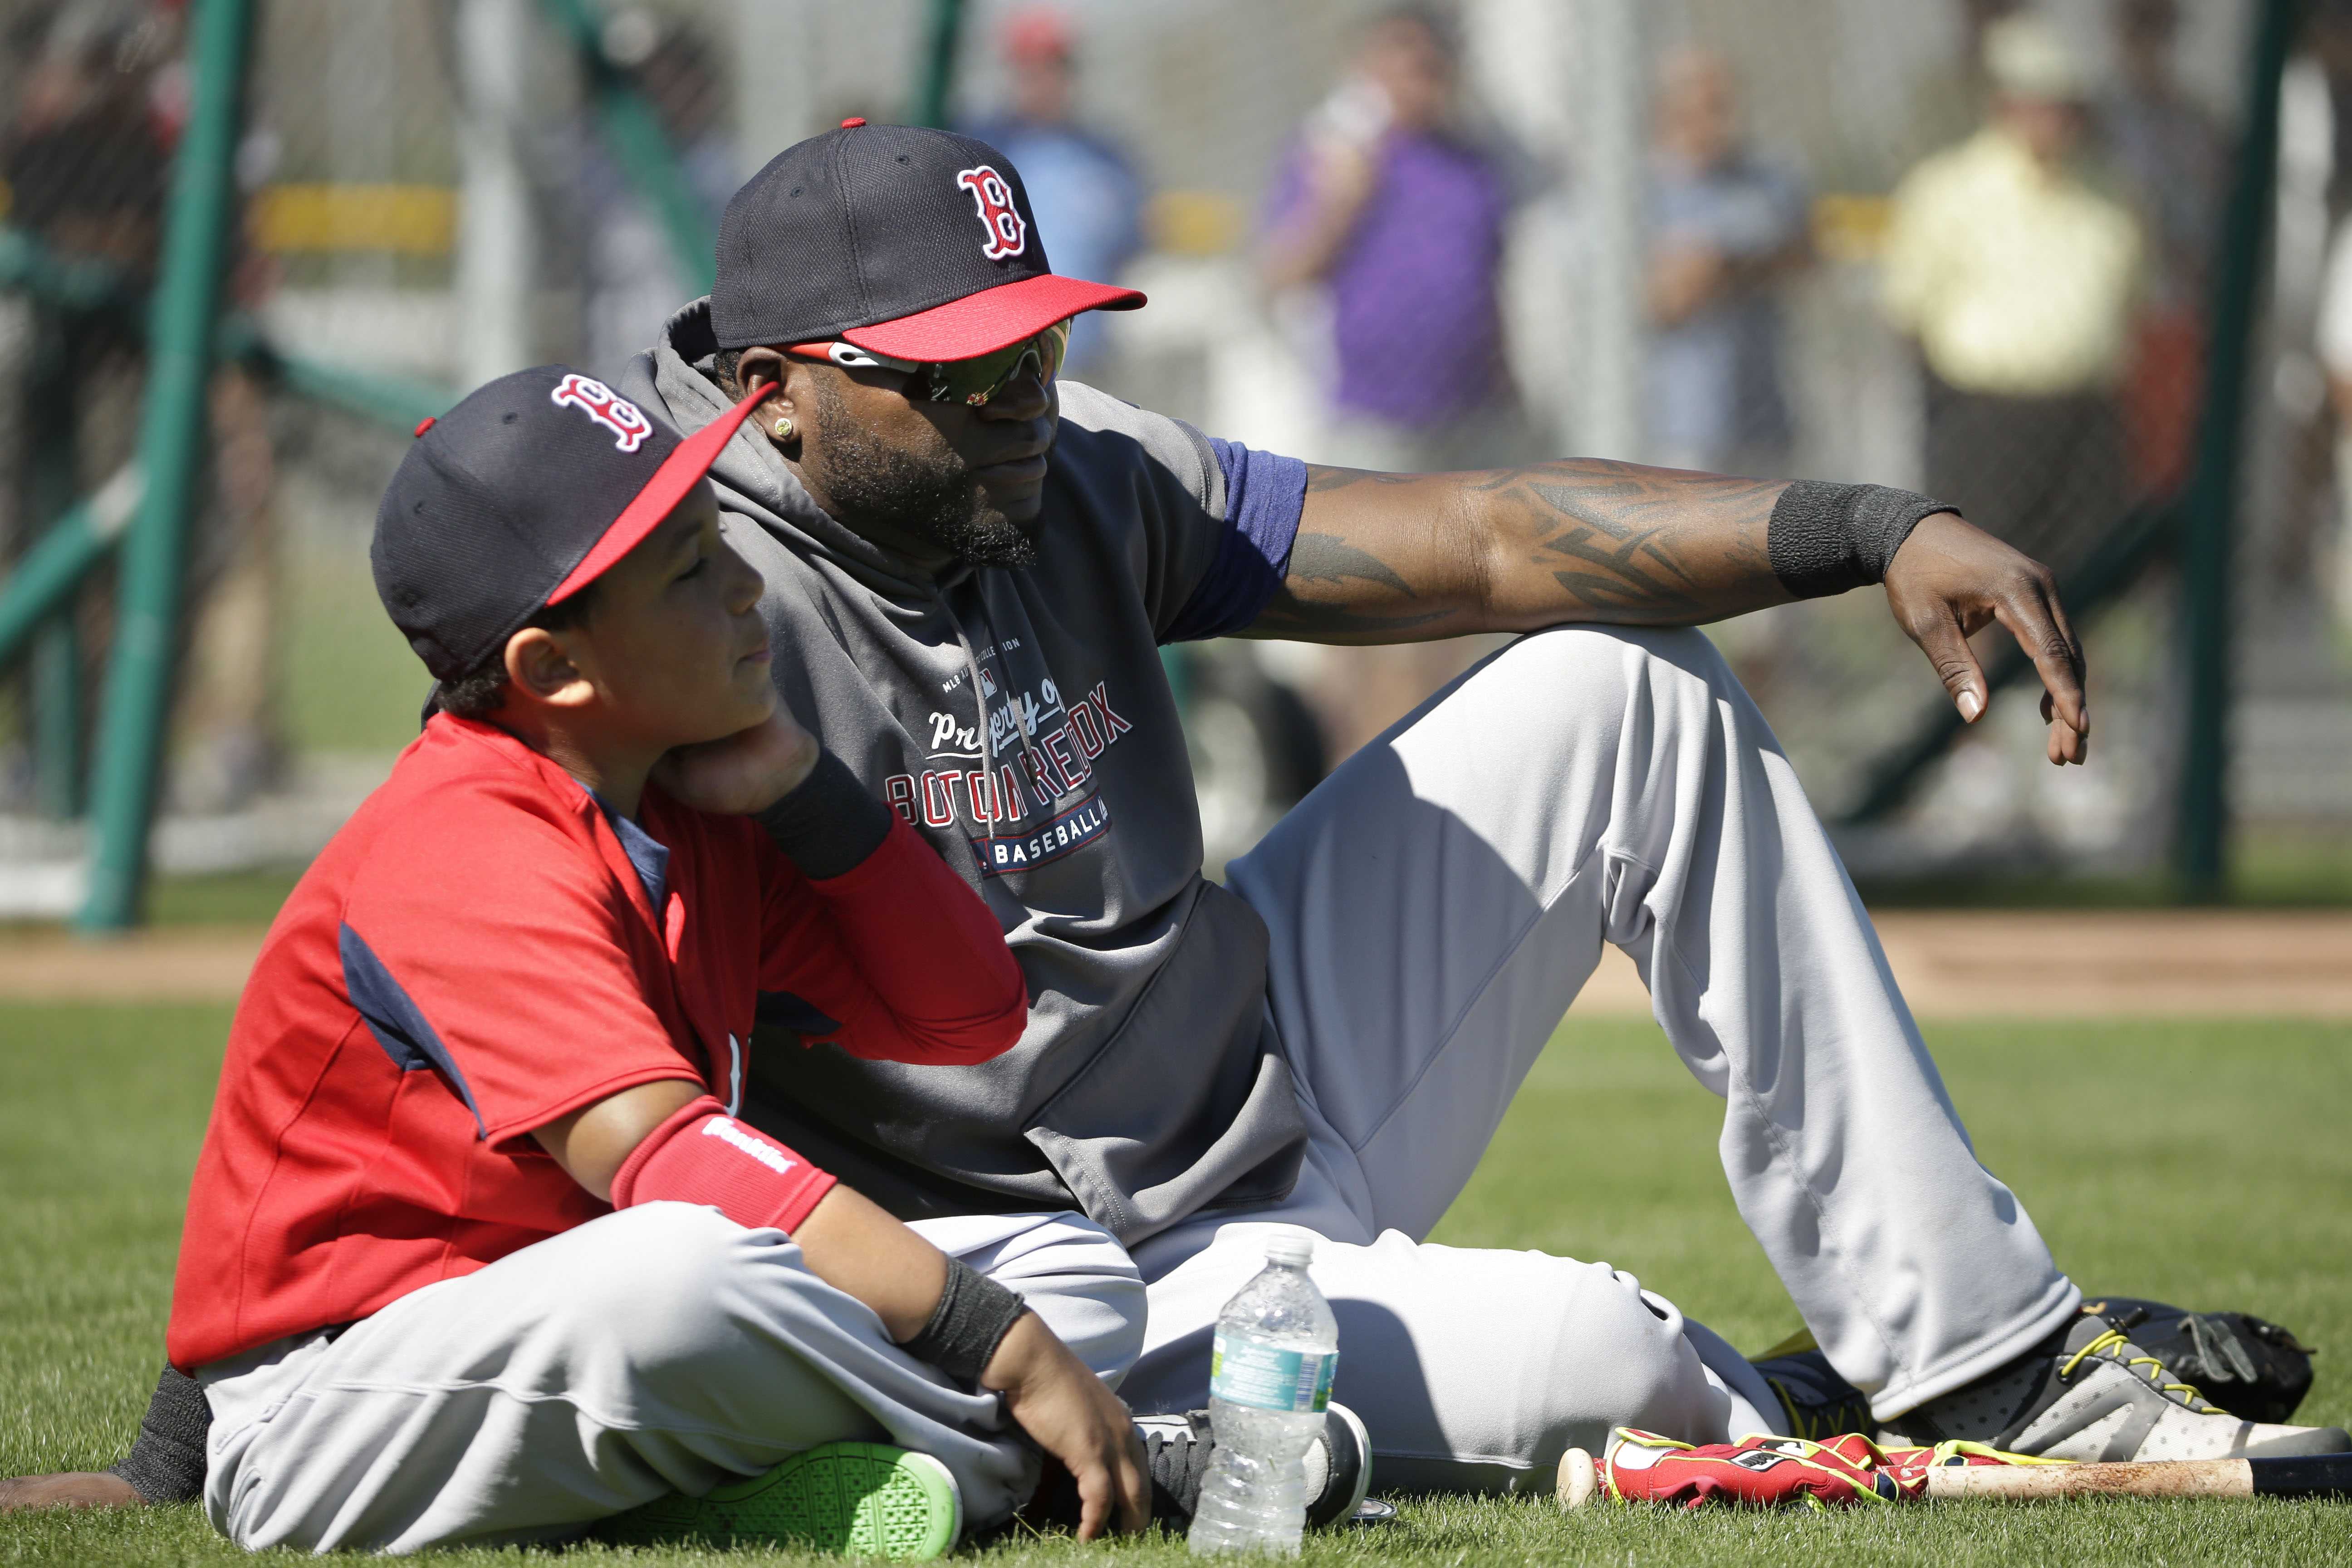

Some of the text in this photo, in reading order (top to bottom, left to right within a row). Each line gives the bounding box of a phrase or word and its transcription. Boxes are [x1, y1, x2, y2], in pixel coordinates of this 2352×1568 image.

[957, 165, 1026, 260] B
[551, 373, 653, 453] B
[942, 638, 1020, 693] MLB COLLEION
[885, 762, 1029, 828] BOTON
[1067, 680, 1134, 760] OX
[994, 808, 1101, 864] BASEBALL
